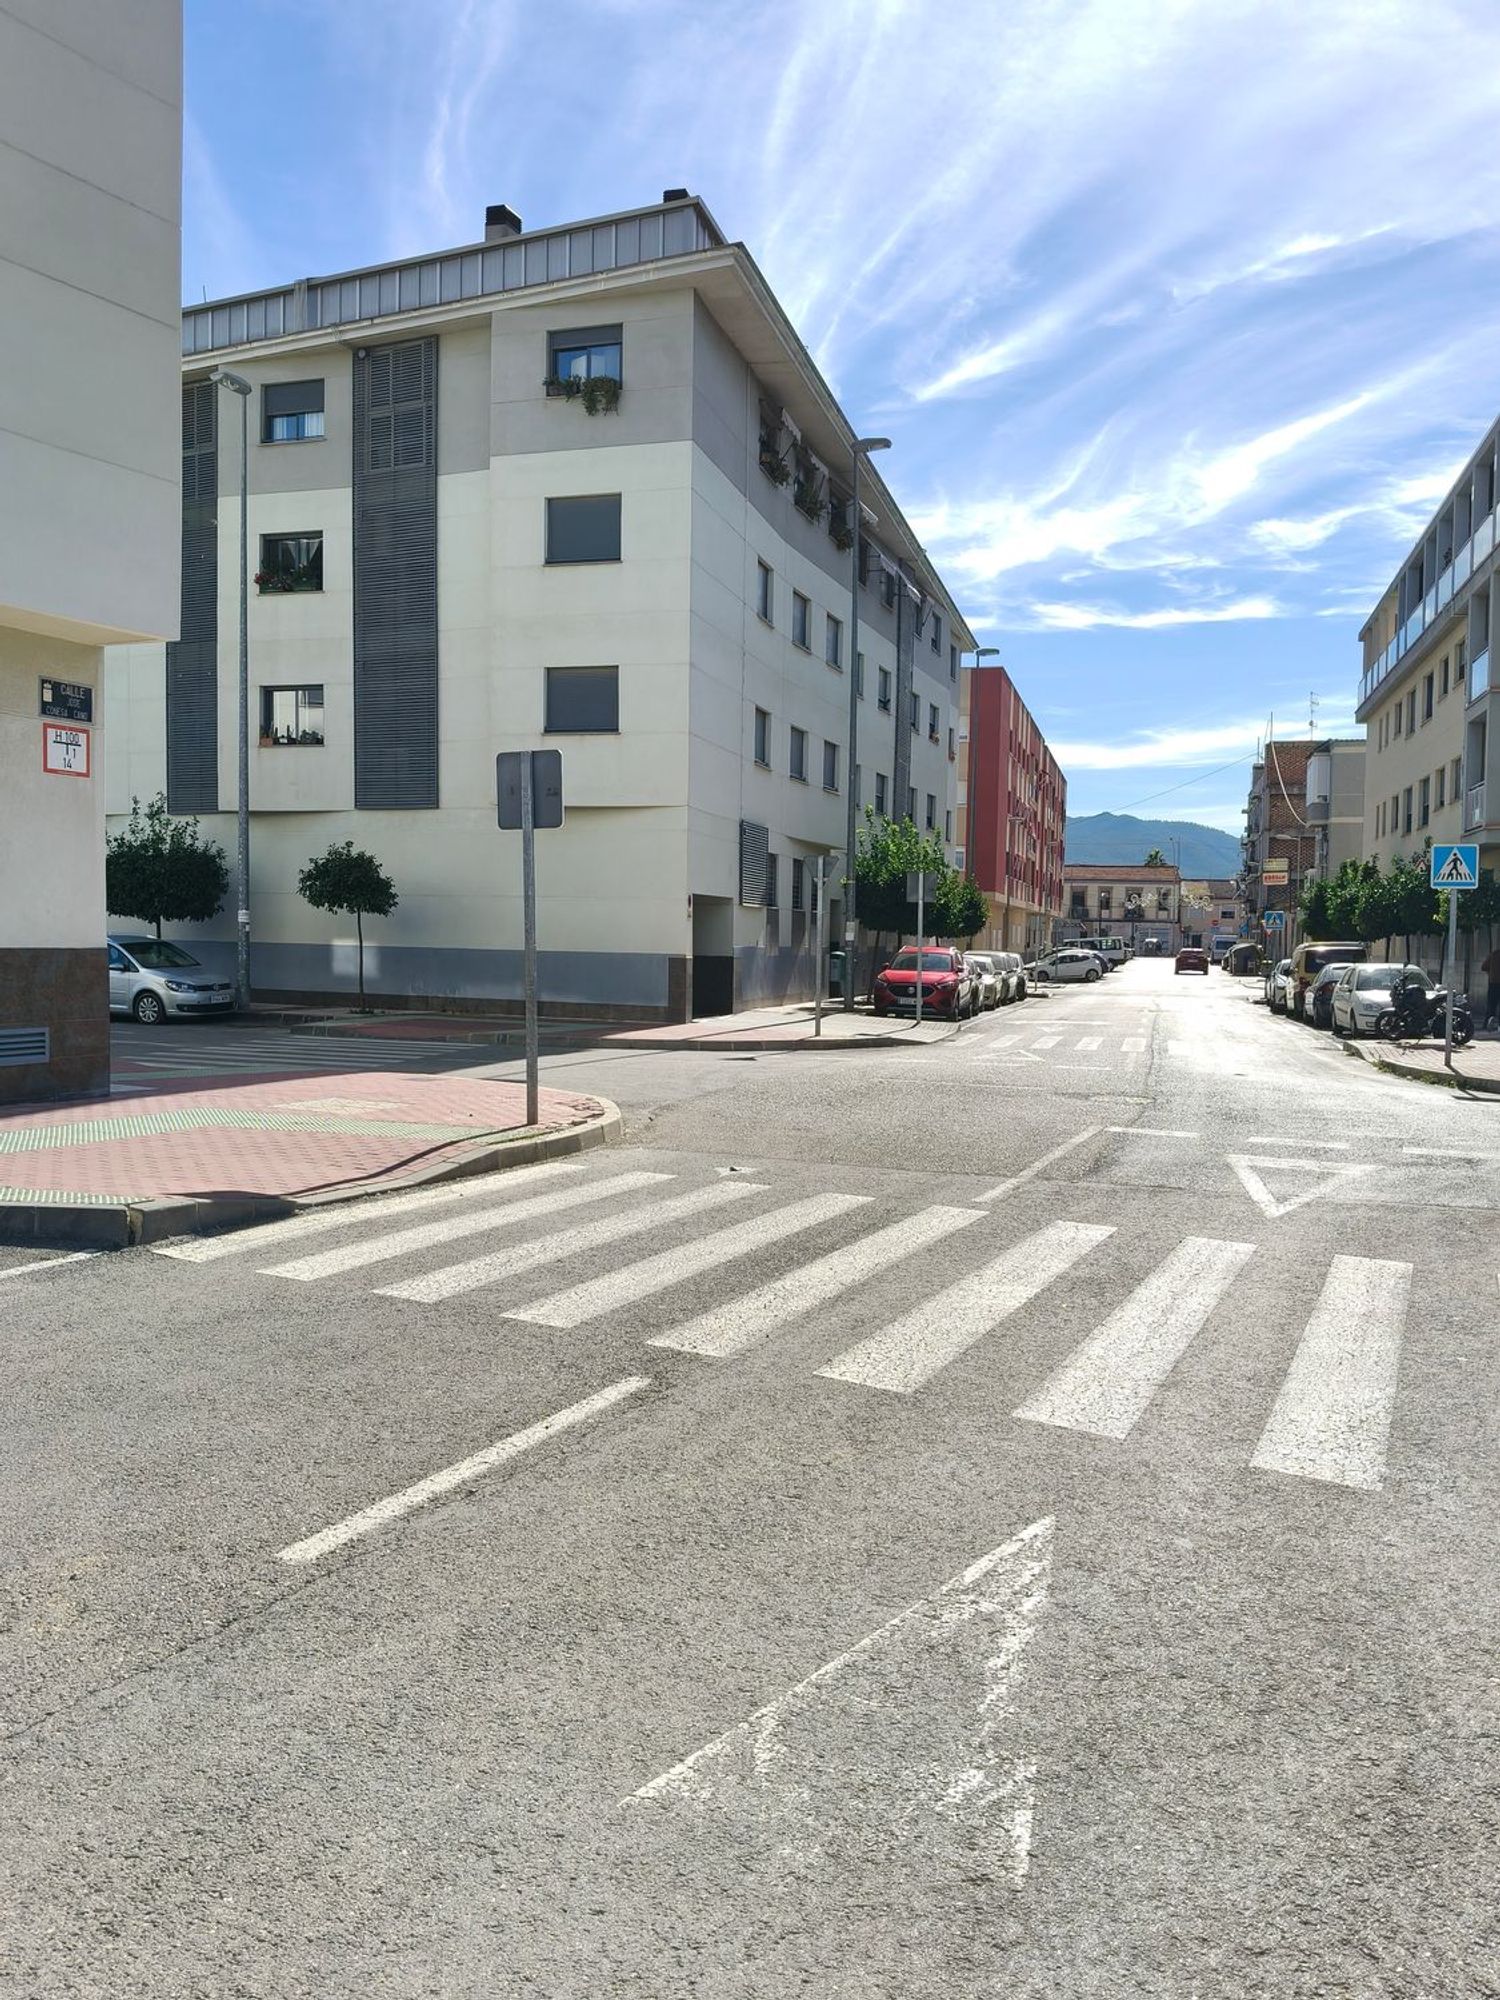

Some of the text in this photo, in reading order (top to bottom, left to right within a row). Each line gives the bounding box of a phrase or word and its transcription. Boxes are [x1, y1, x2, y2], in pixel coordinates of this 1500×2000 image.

[61, 684, 86, 699] CALLE
[55, 730, 80, 744] H 100
[63, 757, 72, 769] 14
